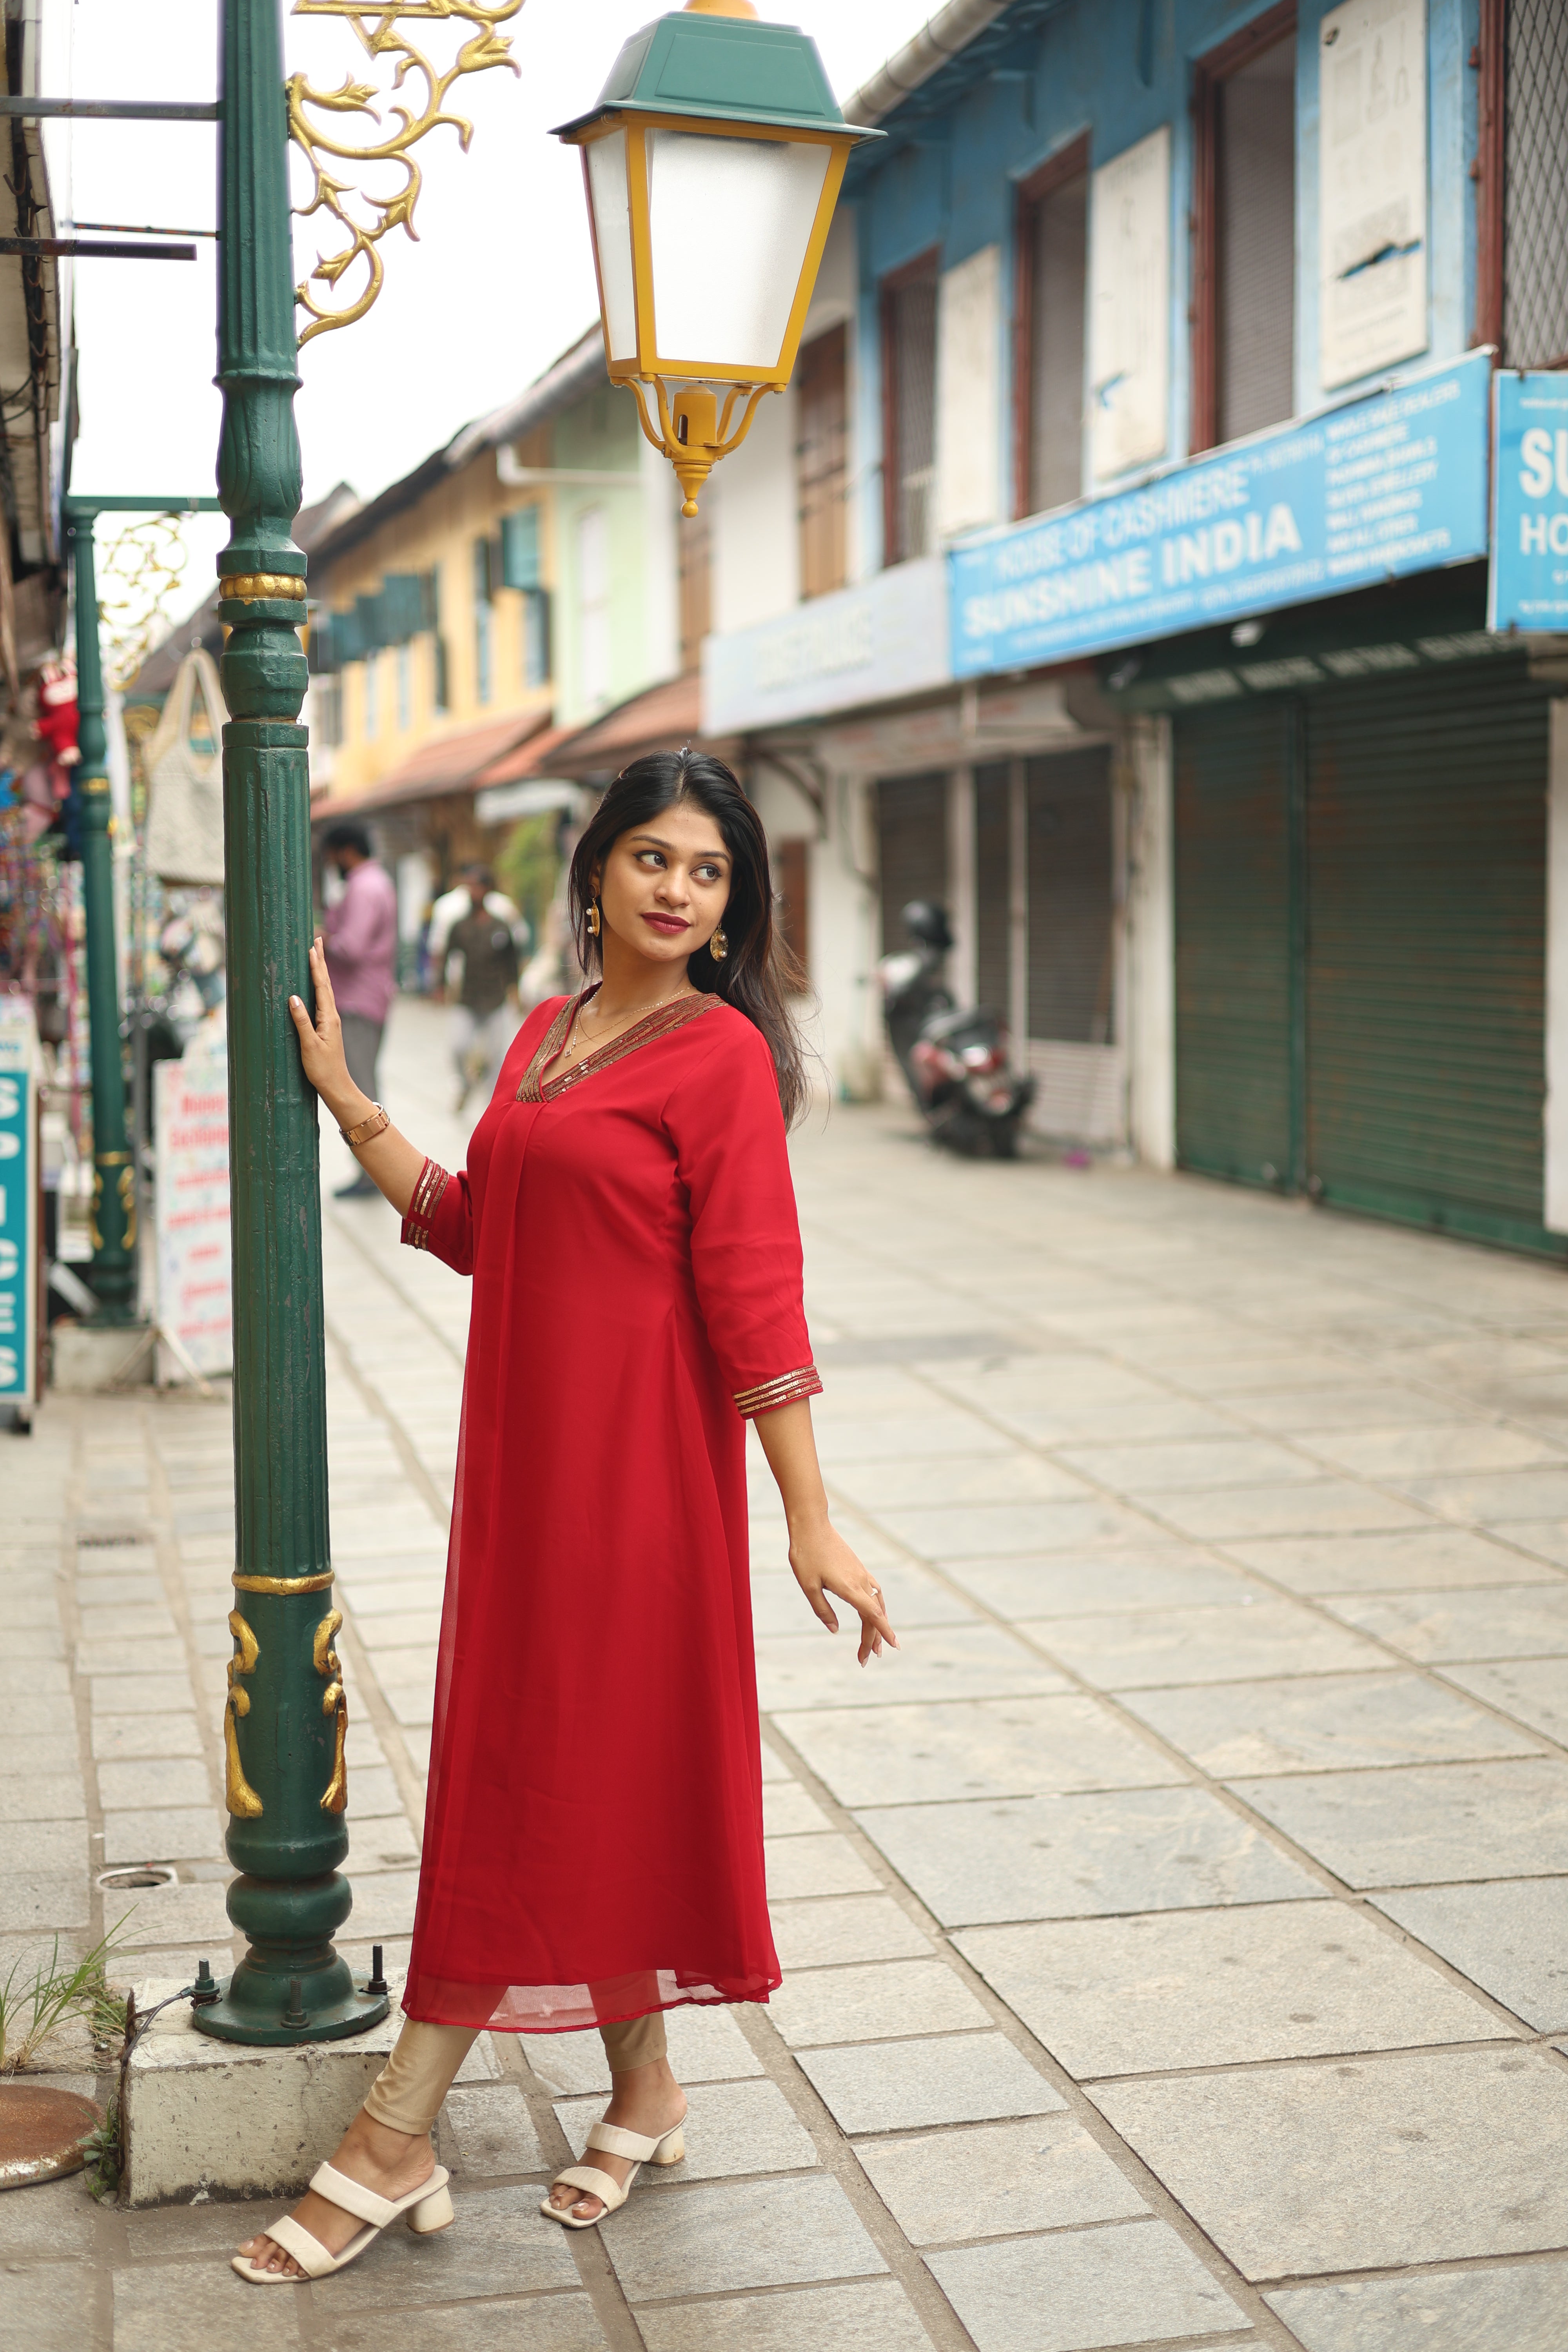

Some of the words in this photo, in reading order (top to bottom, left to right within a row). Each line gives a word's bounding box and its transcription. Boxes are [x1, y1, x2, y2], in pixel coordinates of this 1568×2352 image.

[963, 546, 1153, 638] SUNSHINE
[1162, 501, 1303, 587] INDIA
[997, 526, 1065, 578] HOUSE
[1065, 512, 1097, 558] OF
[1102, 463, 1250, 545] CASHMERE
